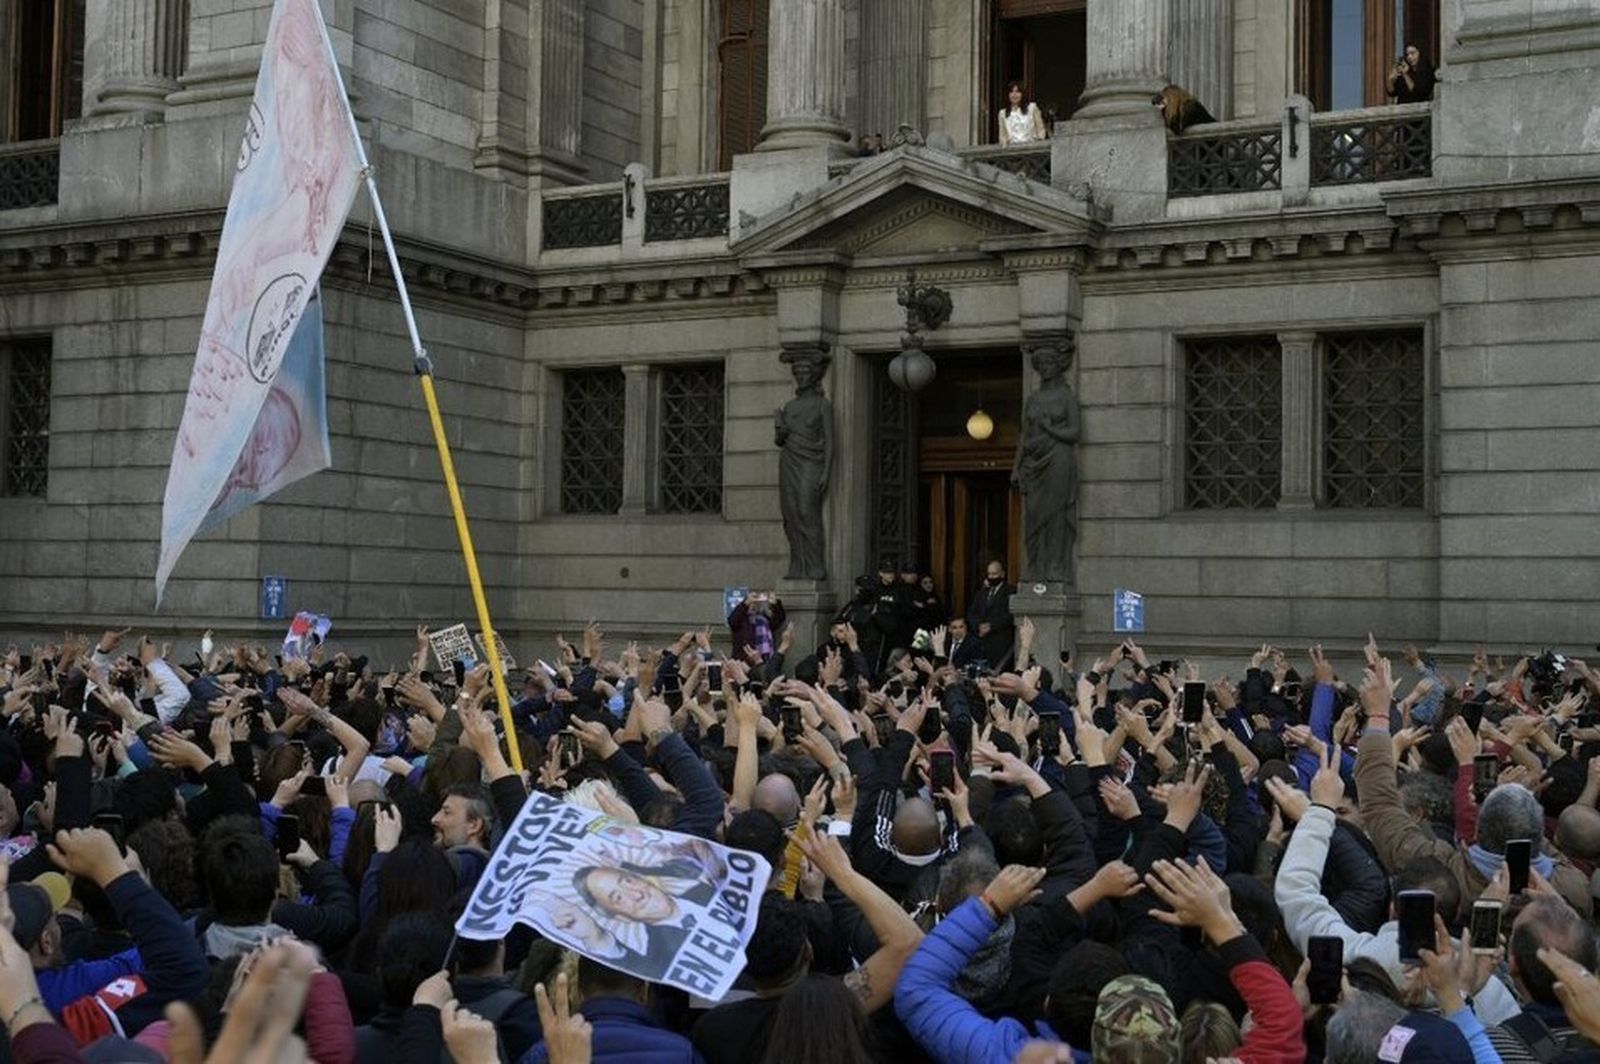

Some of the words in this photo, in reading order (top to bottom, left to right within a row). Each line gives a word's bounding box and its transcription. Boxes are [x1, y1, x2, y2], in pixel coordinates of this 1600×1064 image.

[464, 796, 564, 931] NESTOR
[691, 928, 741, 964] EL
[669, 951, 724, 996] EN
